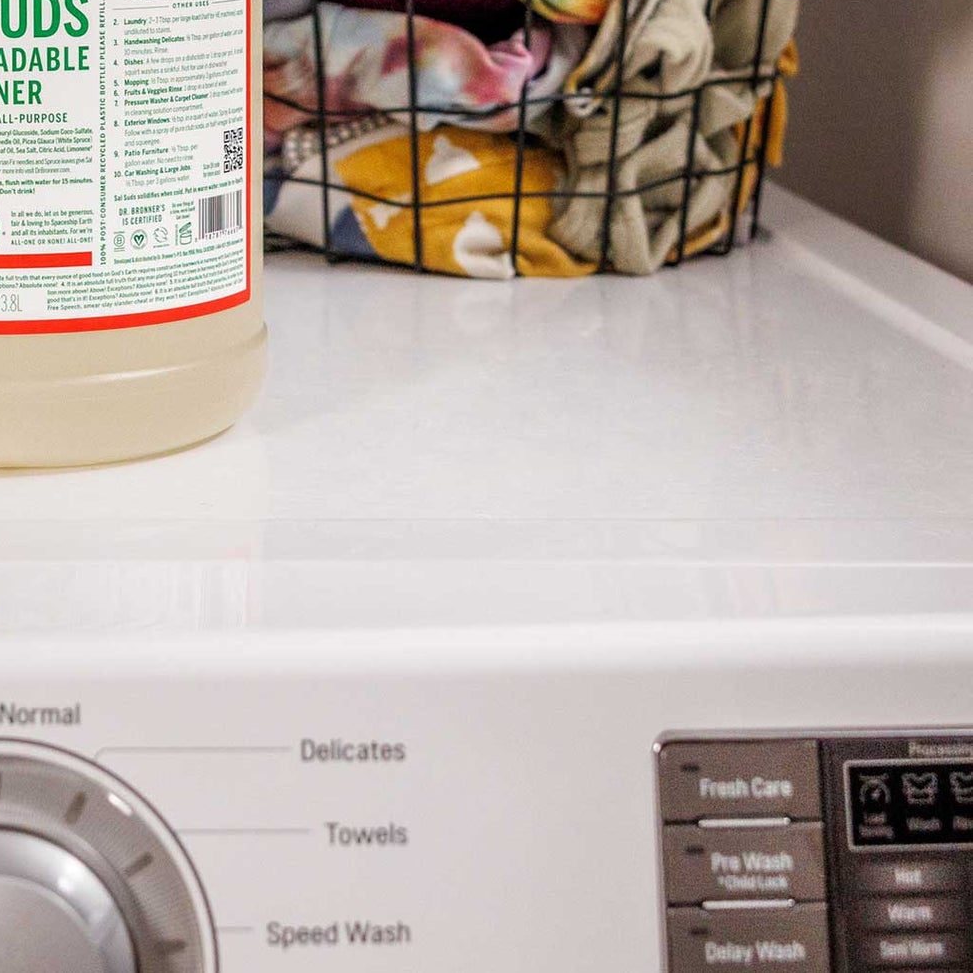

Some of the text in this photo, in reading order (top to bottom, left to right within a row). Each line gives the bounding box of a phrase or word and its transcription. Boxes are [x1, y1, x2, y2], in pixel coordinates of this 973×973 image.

[124, 37, 160, 45] Handwashing
[147, 88, 167, 96] Veggies
[175, 94, 191, 103] Carpet
[136, 168, 159, 176] Washing
[165, 166, 179, 174] Large
[131, 215, 162, 225] CERTIFIED
[301, 739, 405, 762] Delicates
[699, 776, 793, 798] Fresh Care
[327, 822, 408, 845] Towels
[711, 851, 794, 873] Pre Wash
[267, 922, 410, 948] Speed Wash
[704, 940, 807, 967] Delay Wash
